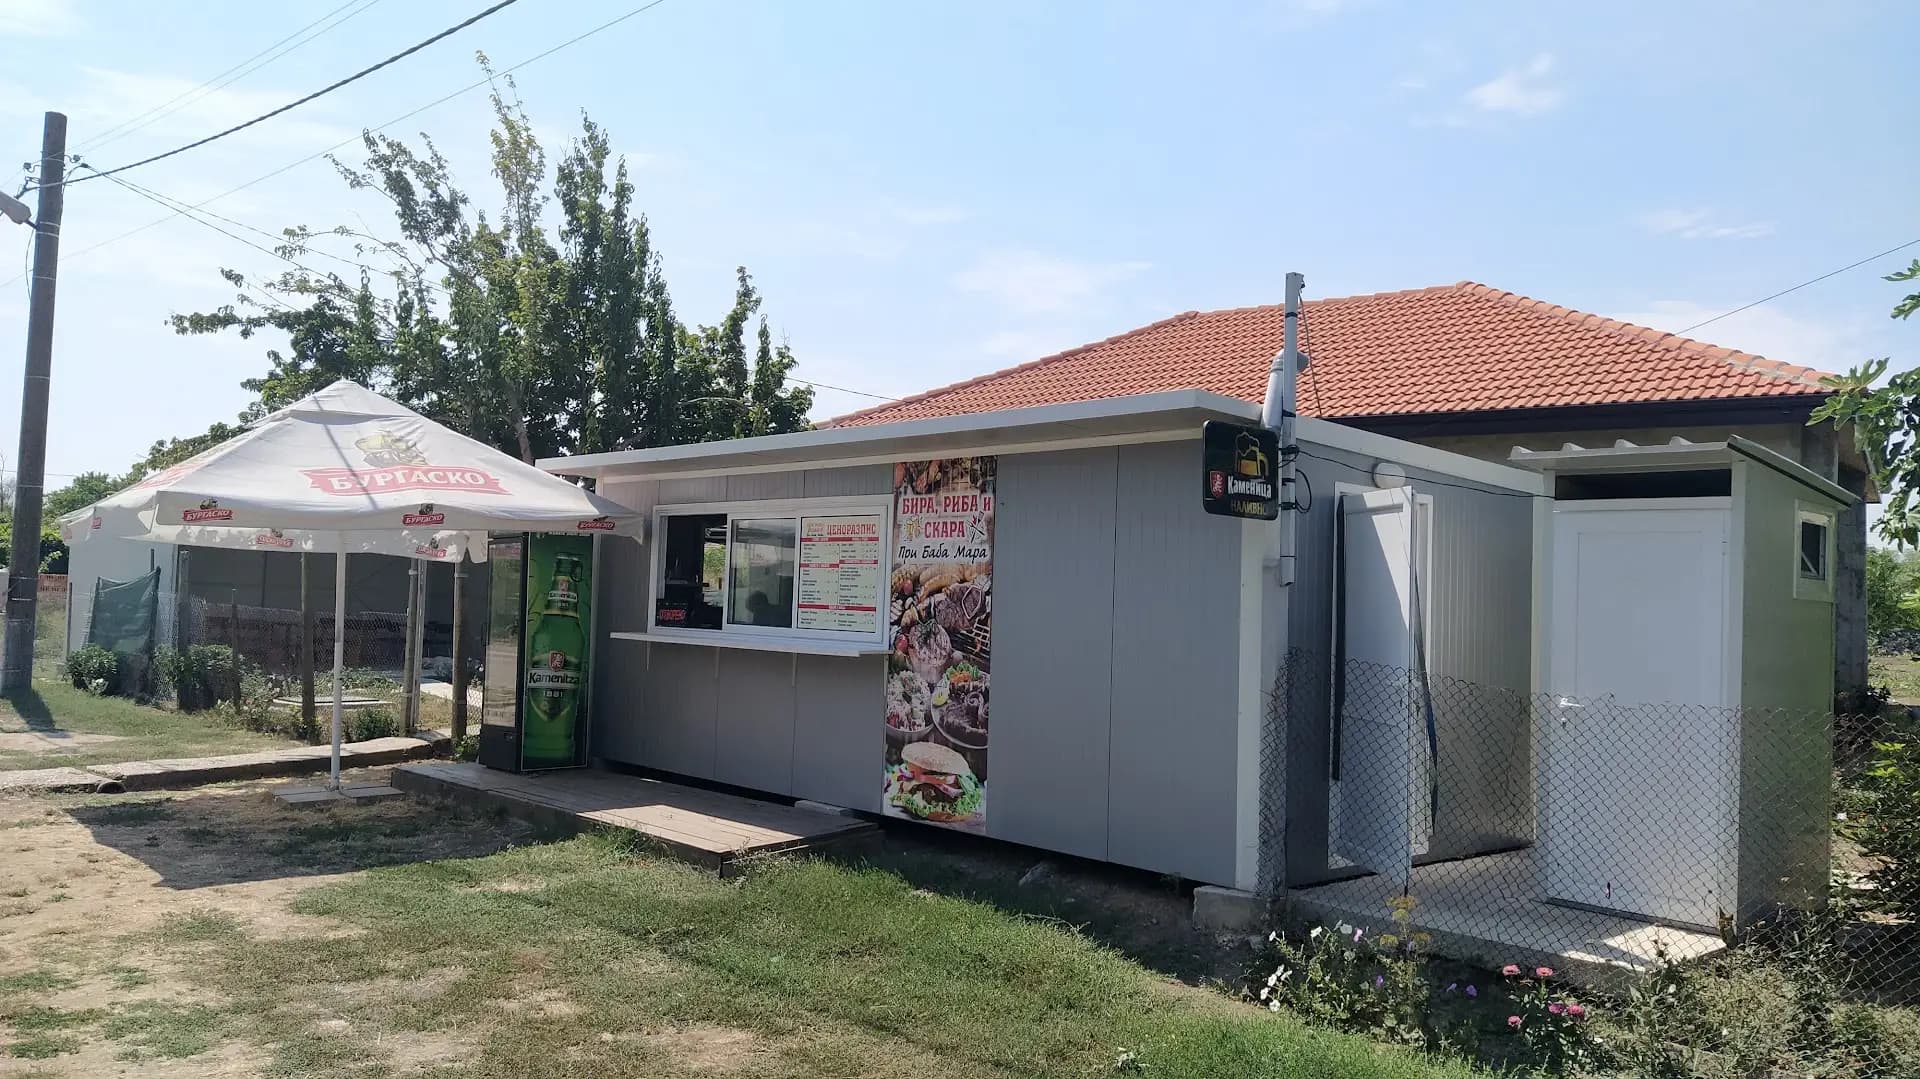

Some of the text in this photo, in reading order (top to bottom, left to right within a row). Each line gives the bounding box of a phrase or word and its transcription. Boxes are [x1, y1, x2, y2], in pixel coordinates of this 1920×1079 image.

[328, 471, 486, 490] БУРГАСКО
[1227, 475, 1272, 499] Каменица
[902, 497, 938, 515] БИРА,
[943, 495, 979, 513] РИБА
[186, 510, 230, 521] БУРГАСКО
[827, 523, 877, 536] ЦЕНОРАЗПИС
[924, 520, 966, 538] СКАРА
[898, 545, 917, 565] При
[922, 542, 949, 559] Баба
[953, 544, 988, 564] Мара
[528, 672, 580, 684] Kamenitza
